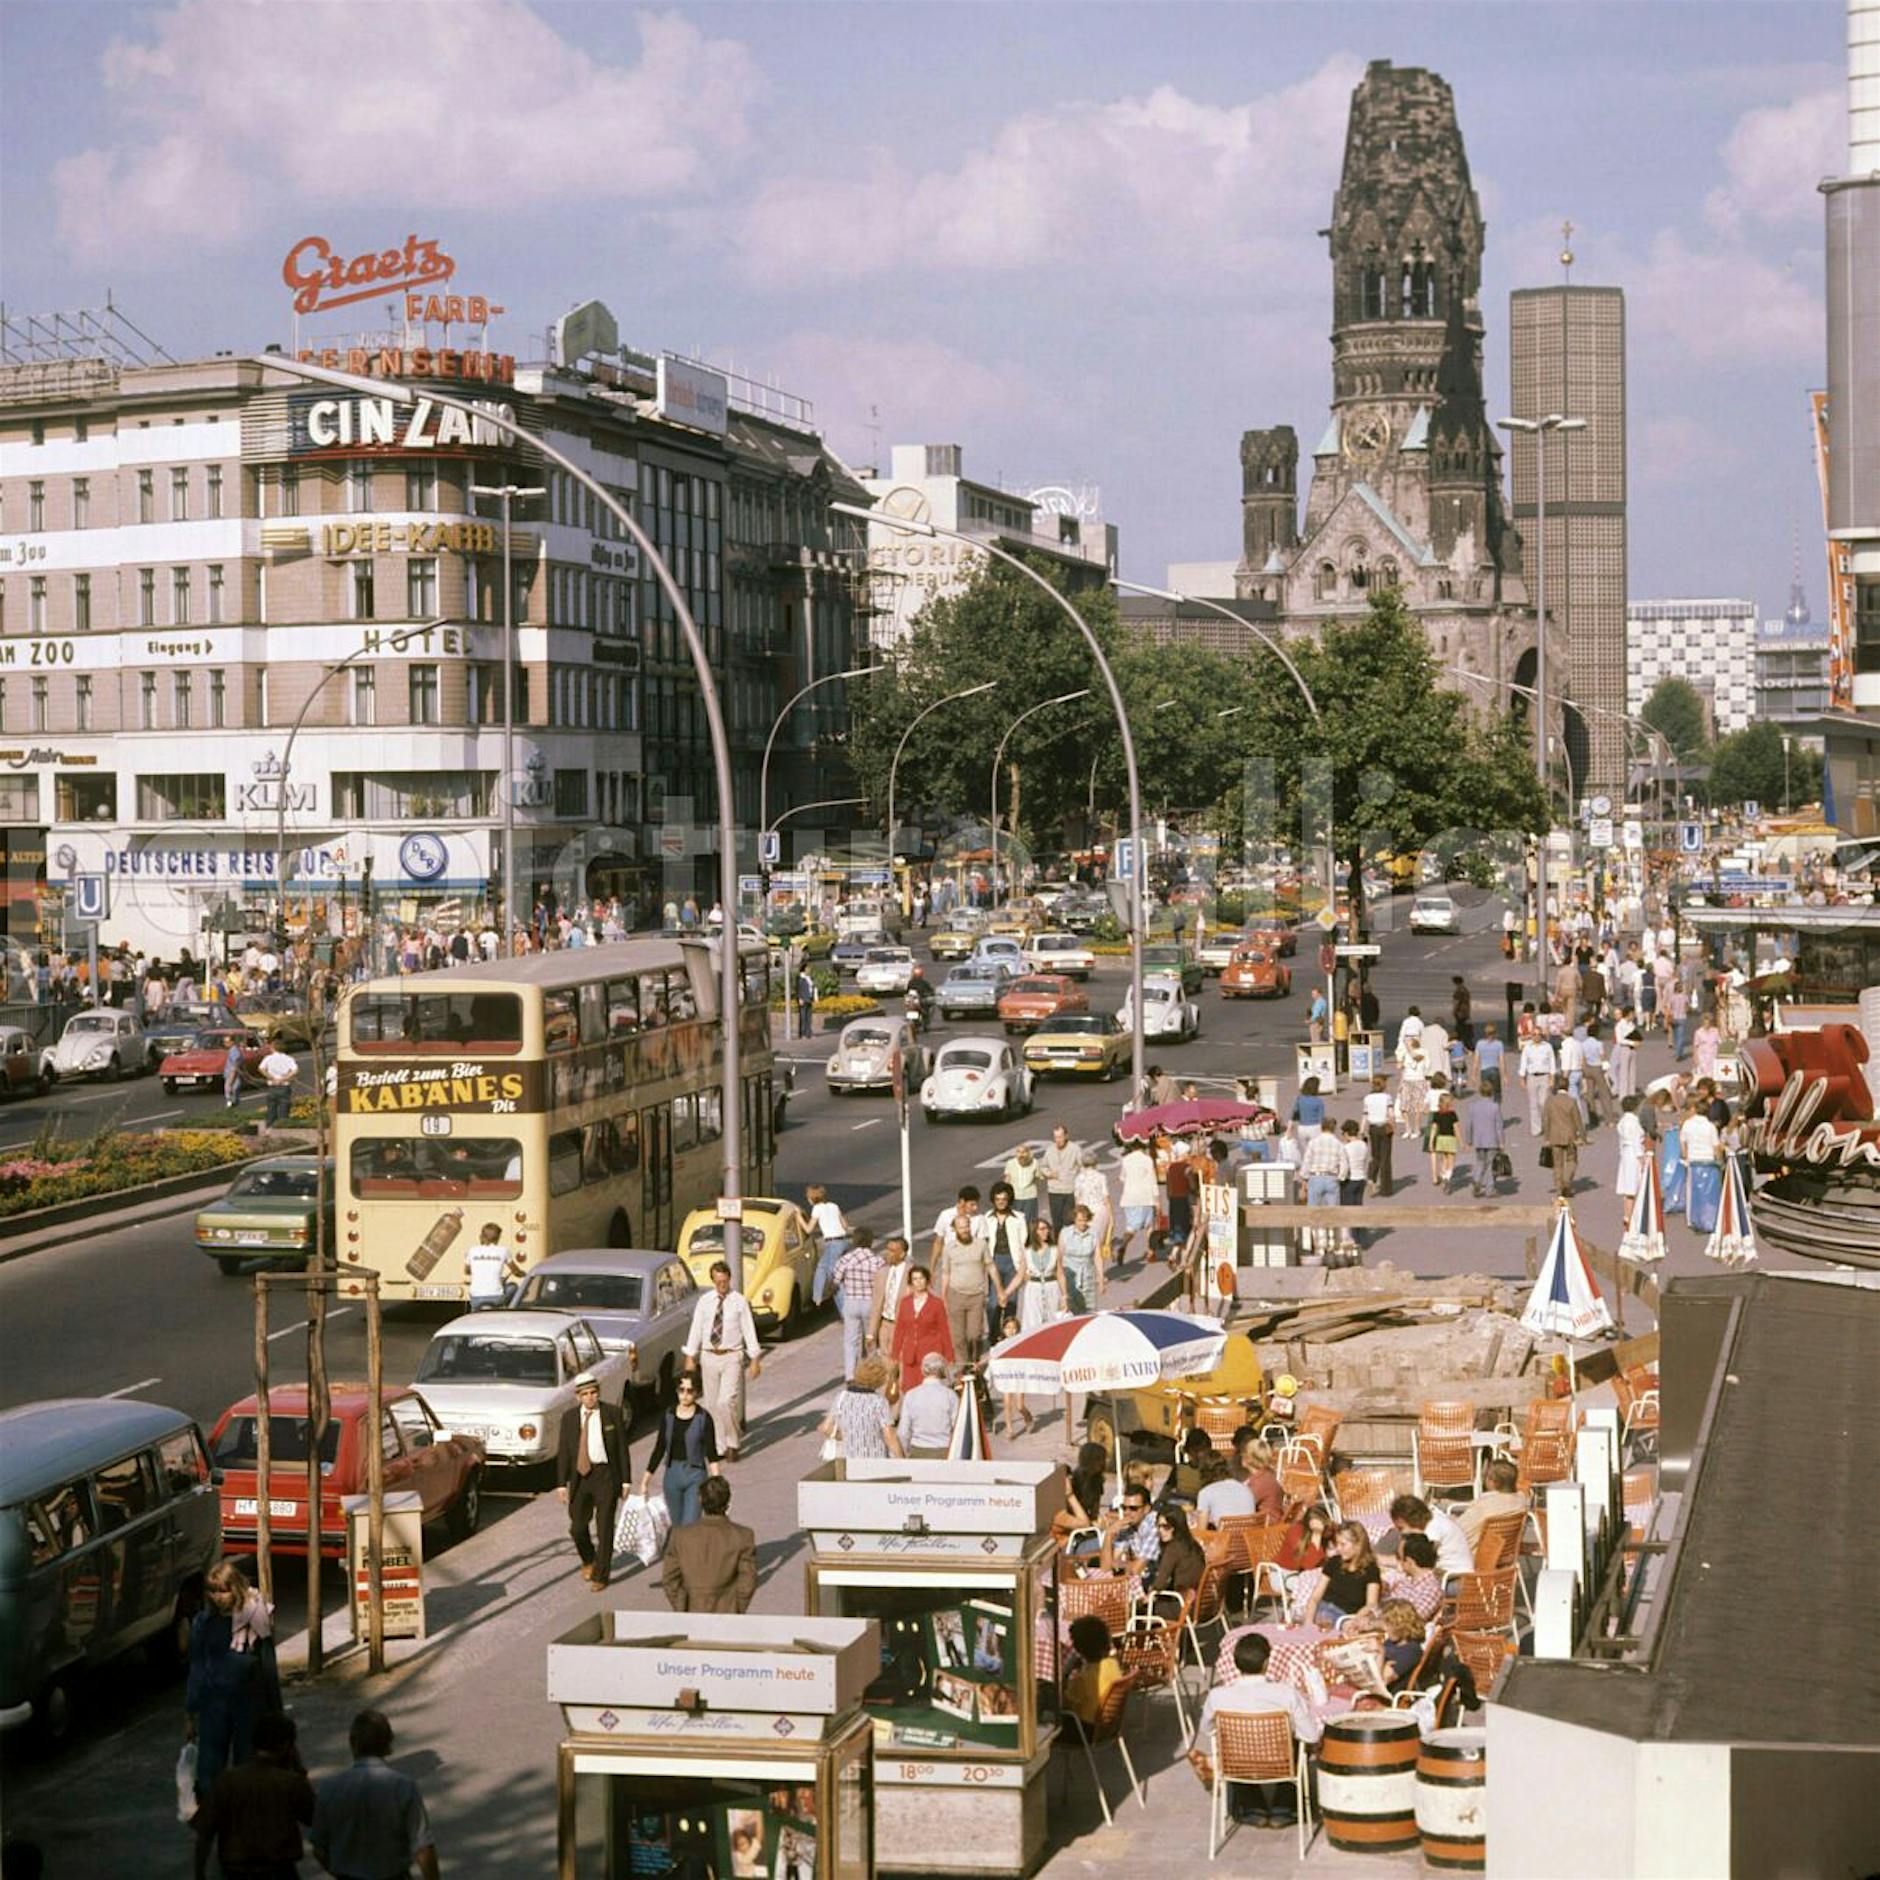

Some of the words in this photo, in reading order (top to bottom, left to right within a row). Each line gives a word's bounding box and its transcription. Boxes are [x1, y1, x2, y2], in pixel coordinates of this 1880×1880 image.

[283, 234, 457, 315] Graetz
[406, 293, 506, 324] FARB-
[308, 398, 517, 448] CINZANO
[30, 640, 75, 666] ZOO
[147, 640, 201, 656] Eingang
[363, 628, 473, 655] HOTEL
[235, 782, 317, 812] KLM
[1683, 826, 1699, 850] U
[105, 851, 218, 875] DEUTSCHES
[411, 842, 435, 870] DER
[79, 879, 101, 913] U
[411, 1067, 449, 1082] zum
[451, 1062, 485, 1079] Bier
[349, 1073, 524, 1114] KABÄNES
[425, 1117, 441, 1133] 19
[1204, 1187, 1230, 1216] EIS
[1062, 1366, 1097, 1384] LORD
[887, 1492, 922, 1505] Unser
[925, 1494, 985, 1508] Programm
[988, 1496, 1022, 1508] heute
[656, 1661, 697, 1676] Unser
[701, 1663, 773, 1681] Programm
[775, 1667, 815, 1681] heute
